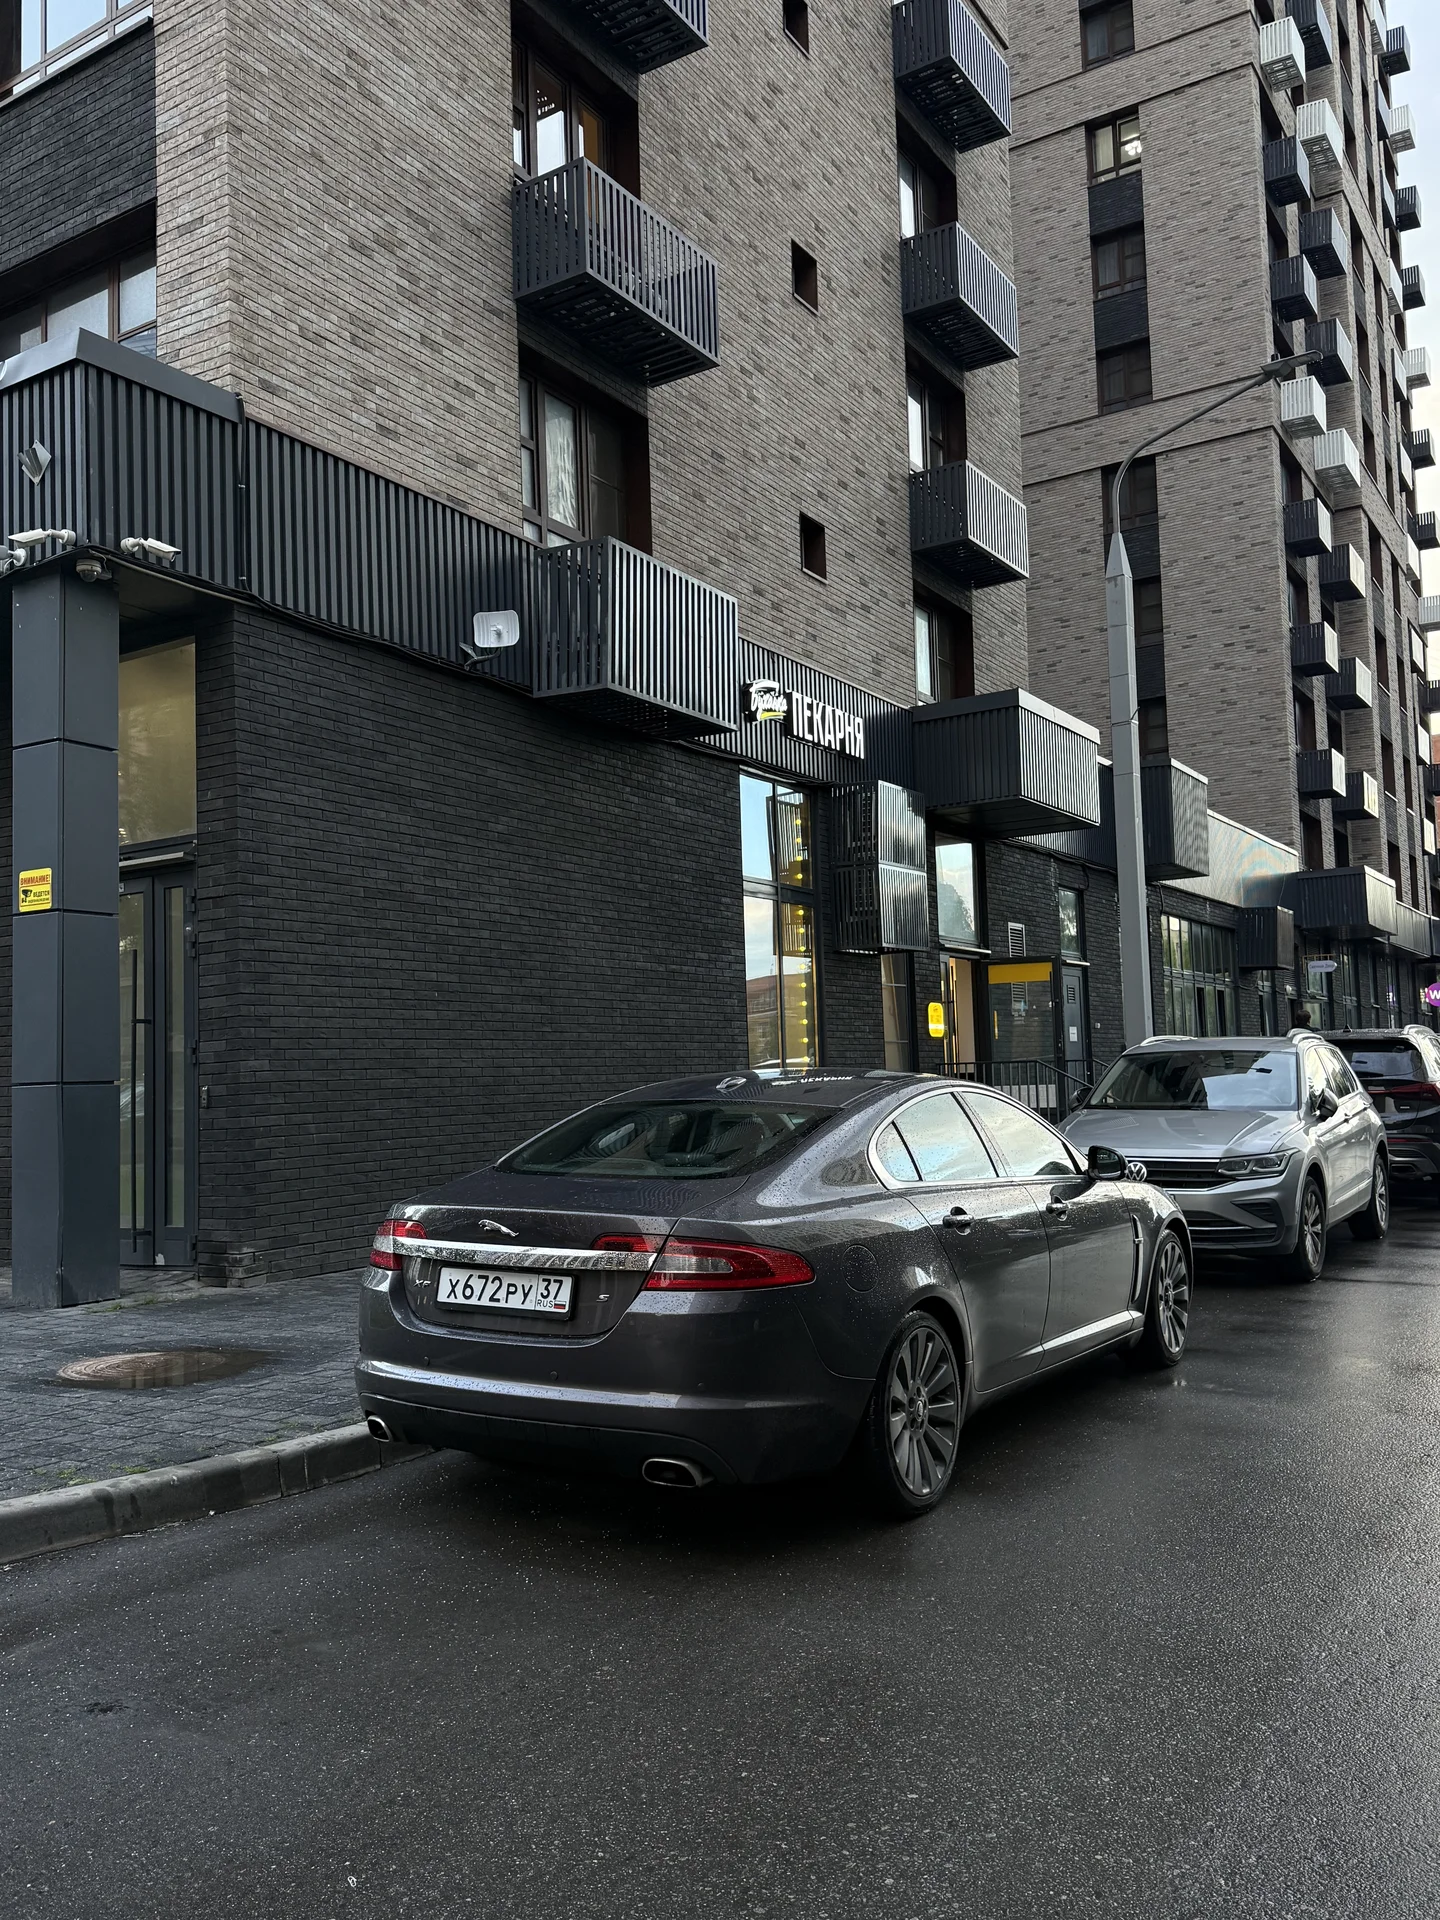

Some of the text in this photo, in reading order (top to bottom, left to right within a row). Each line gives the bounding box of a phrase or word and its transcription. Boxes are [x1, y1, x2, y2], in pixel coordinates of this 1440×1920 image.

[792, 690, 865, 759] ПЕКАРНЯ
[20, 874, 50, 885] ВНИМАНИЕ!
[413, 1279, 431, 1289] XF
[446, 1273, 564, 1305] Х672РУ 37
[536, 1299, 554, 1309] RUS
